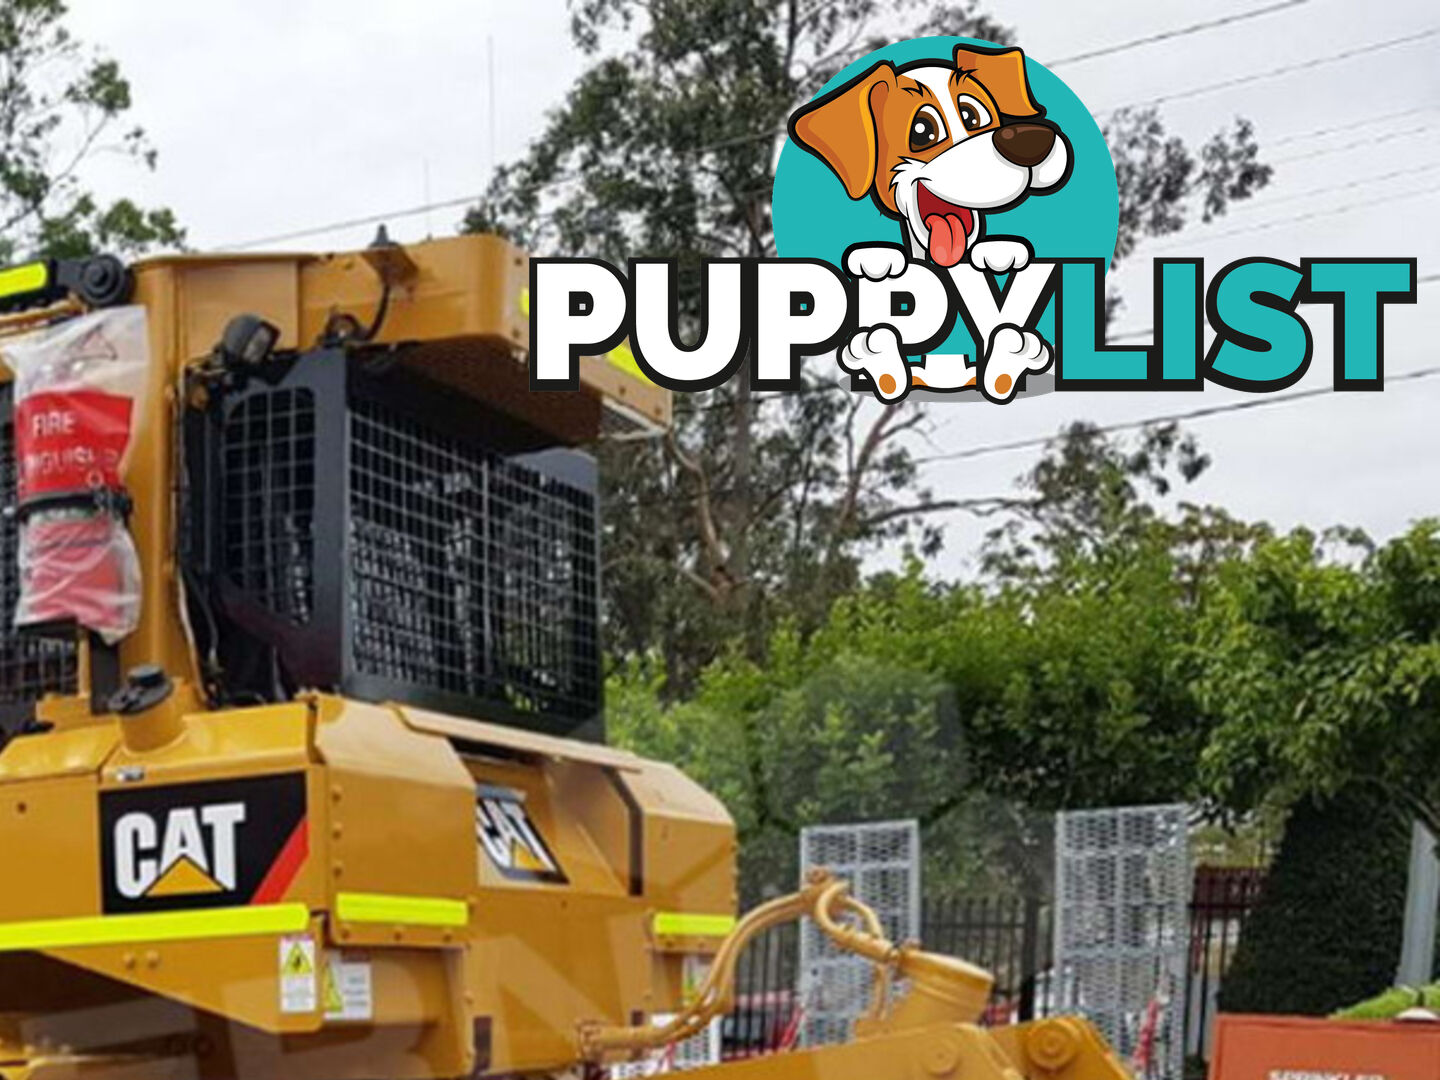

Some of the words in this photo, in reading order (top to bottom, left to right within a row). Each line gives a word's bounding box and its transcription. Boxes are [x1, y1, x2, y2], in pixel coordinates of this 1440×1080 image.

[32, 411, 77, 437] FIRE
[113, 801, 246, 899] CAT
[476, 797, 558, 872] CAT
